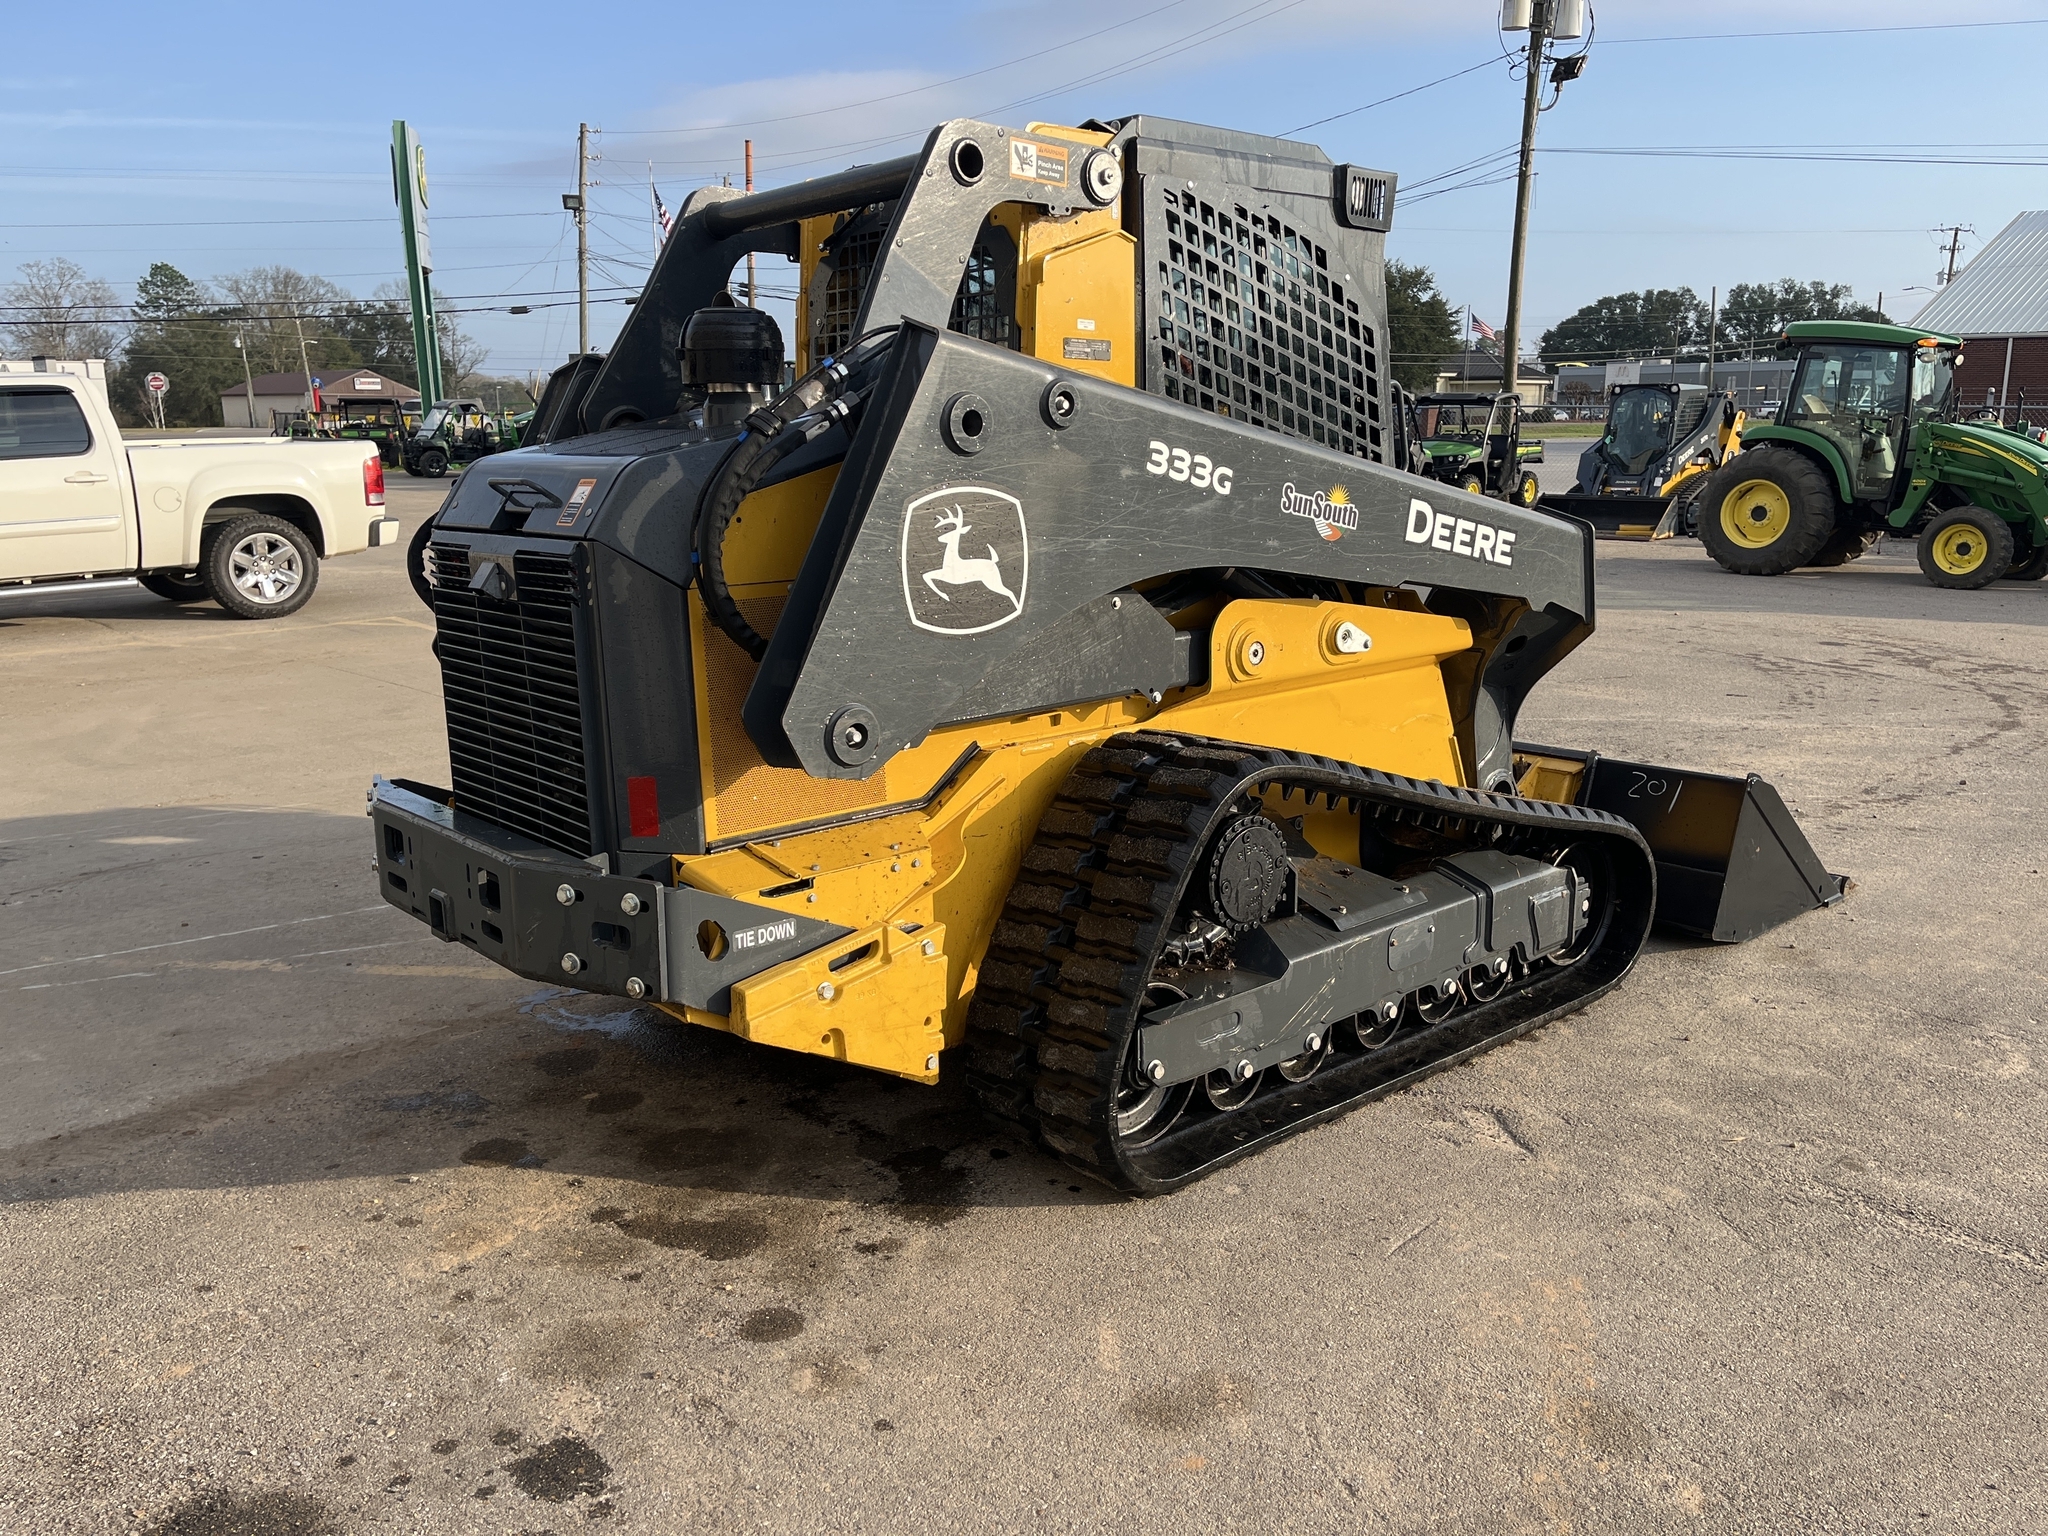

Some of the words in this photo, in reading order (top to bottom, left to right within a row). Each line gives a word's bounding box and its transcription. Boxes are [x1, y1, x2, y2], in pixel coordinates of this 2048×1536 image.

[1038, 160, 1051, 169] Pinch
[1052, 163, 1064, 171] Area
[1146, 441, 1233, 495] 333G
[1281, 483, 1358, 530] SunSouth
[1405, 498, 1516, 566] DEERE
[1628, 771, 1683, 814] 201
[735, 931, 755, 949] TIE
[758, 921, 794, 944] DOWN
